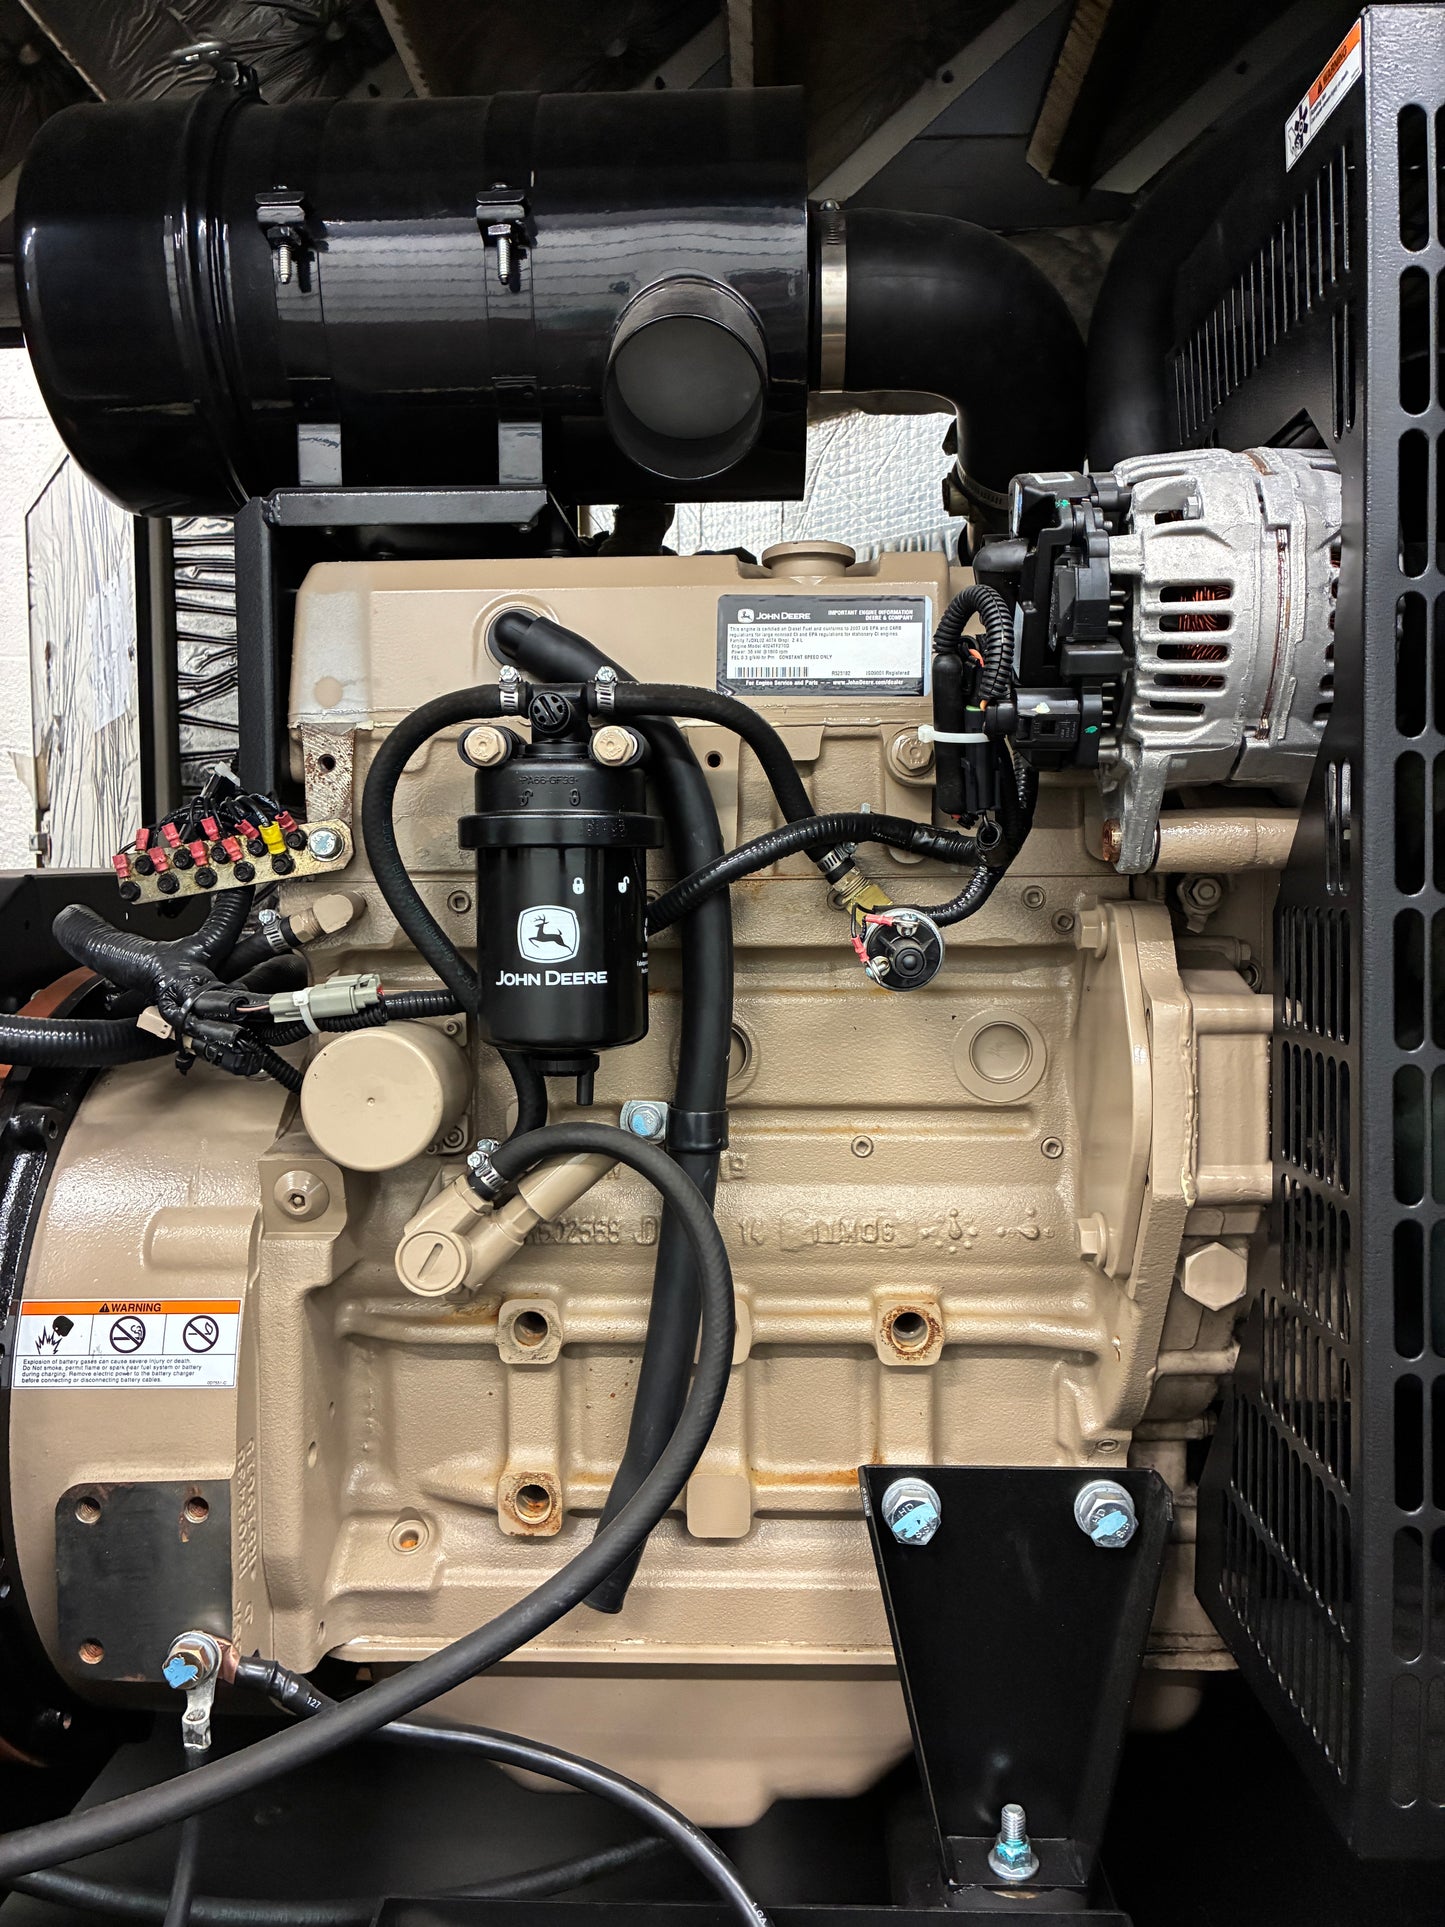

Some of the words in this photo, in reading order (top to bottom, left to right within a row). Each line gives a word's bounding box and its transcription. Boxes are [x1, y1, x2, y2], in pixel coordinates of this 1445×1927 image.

[496, 970, 541, 986] JOHN
[545, 970, 608, 985] DEERE
[112, 1303, 162, 1312] WARNING
[306, 1696, 322, 1709] 127
